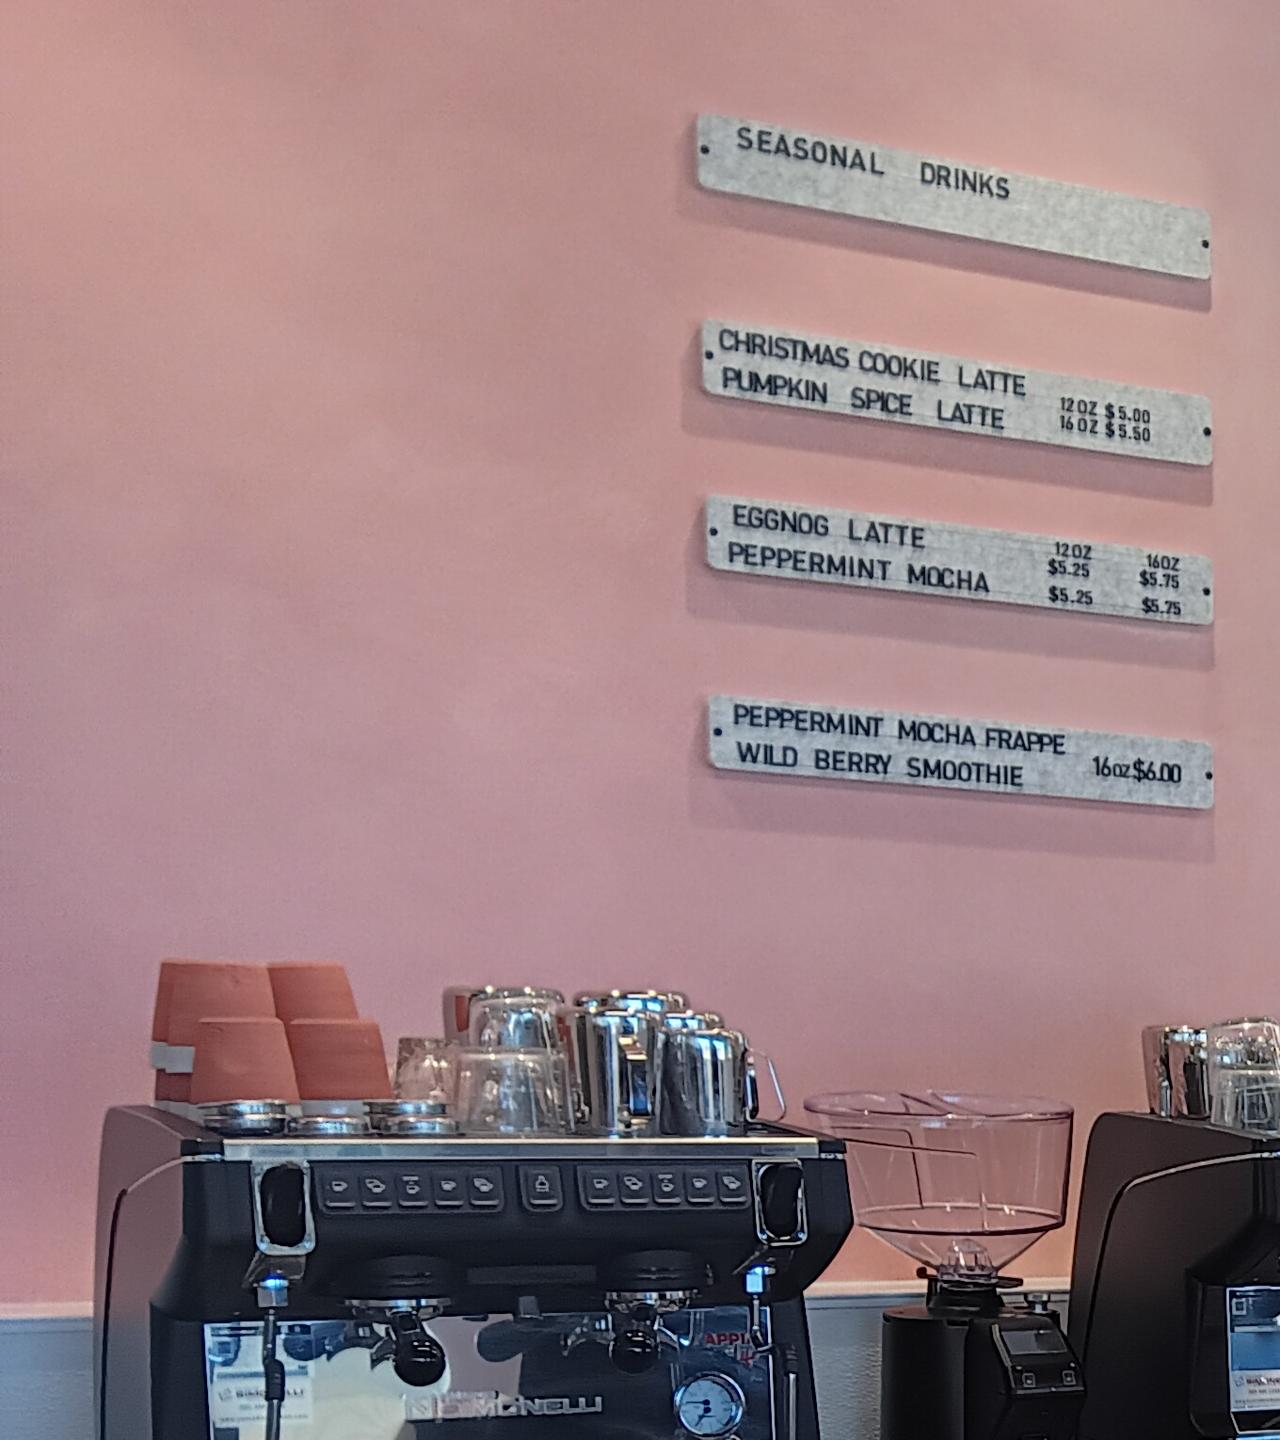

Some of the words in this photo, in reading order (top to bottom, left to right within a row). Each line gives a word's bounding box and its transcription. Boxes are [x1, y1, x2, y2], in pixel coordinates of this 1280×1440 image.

[737, 126, 885, 177] SEASONAL
[920, 161, 1010, 200] DRINKS
[718, 328, 850, 370] CHRISTMAS
[858, 350, 941, 386] COOKIE
[958, 366, 1027, 398] LATTE
[722, 366, 828, 404] PUMPKIN
[850, 386, 913, 417] SPICE
[937, 399, 1005, 431] LATTE
[1104, 402, 1151, 424] $5.00
[1105, 420, 1151, 442] $5.50
[733, 504, 829, 537] EGGNOG
[848, 518, 926, 551] LATTE
[728, 541, 892, 581] PEPPERMINT
[906, 563, 990, 594] MOCHA
[1047, 558, 1090, 579] $5.25
[1139, 569, 1180, 590] $5.75
[1048, 585, 1093, 606] $5.25
[1141, 596, 1182, 616] $5.75
[733, 703, 884, 738] PEPPERMINT
[897, 719, 977, 748] MOCHA
[984, 728, 1066, 756] FRAPPE
[736, 741, 798, 768] WILD
[814, 748, 892, 775] BERRY
[906, 757, 1024, 788] SMOOTHIE
